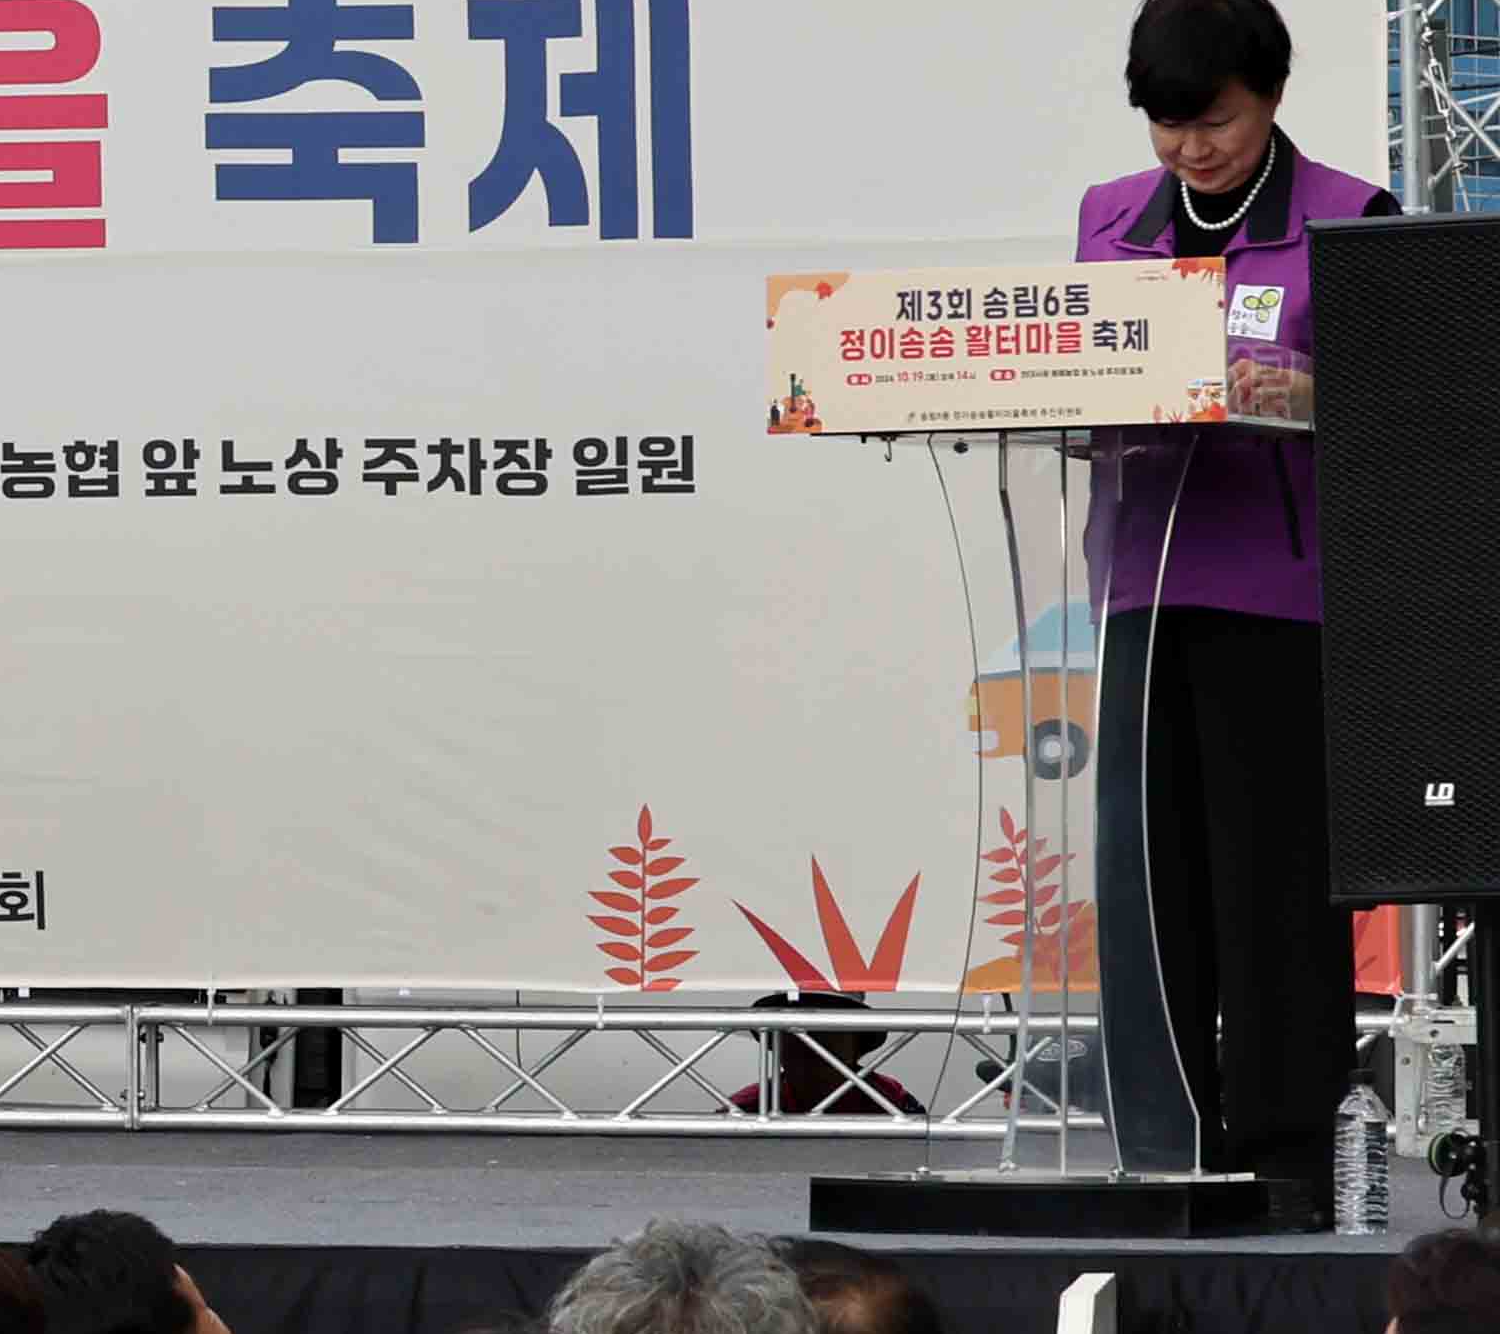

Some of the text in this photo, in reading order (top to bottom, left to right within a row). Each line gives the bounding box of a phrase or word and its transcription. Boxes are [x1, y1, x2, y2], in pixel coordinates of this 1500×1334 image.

[895, 283, 1091, 321] 제3회 송림6동
[840, 319, 1149, 361] 정이송송 활터마을 축제
[142, 439, 200, 497] 앞
[220, 438, 343, 496] 노상
[361, 437, 552, 497] 주차장
[572, 435, 697, 495] 일원
